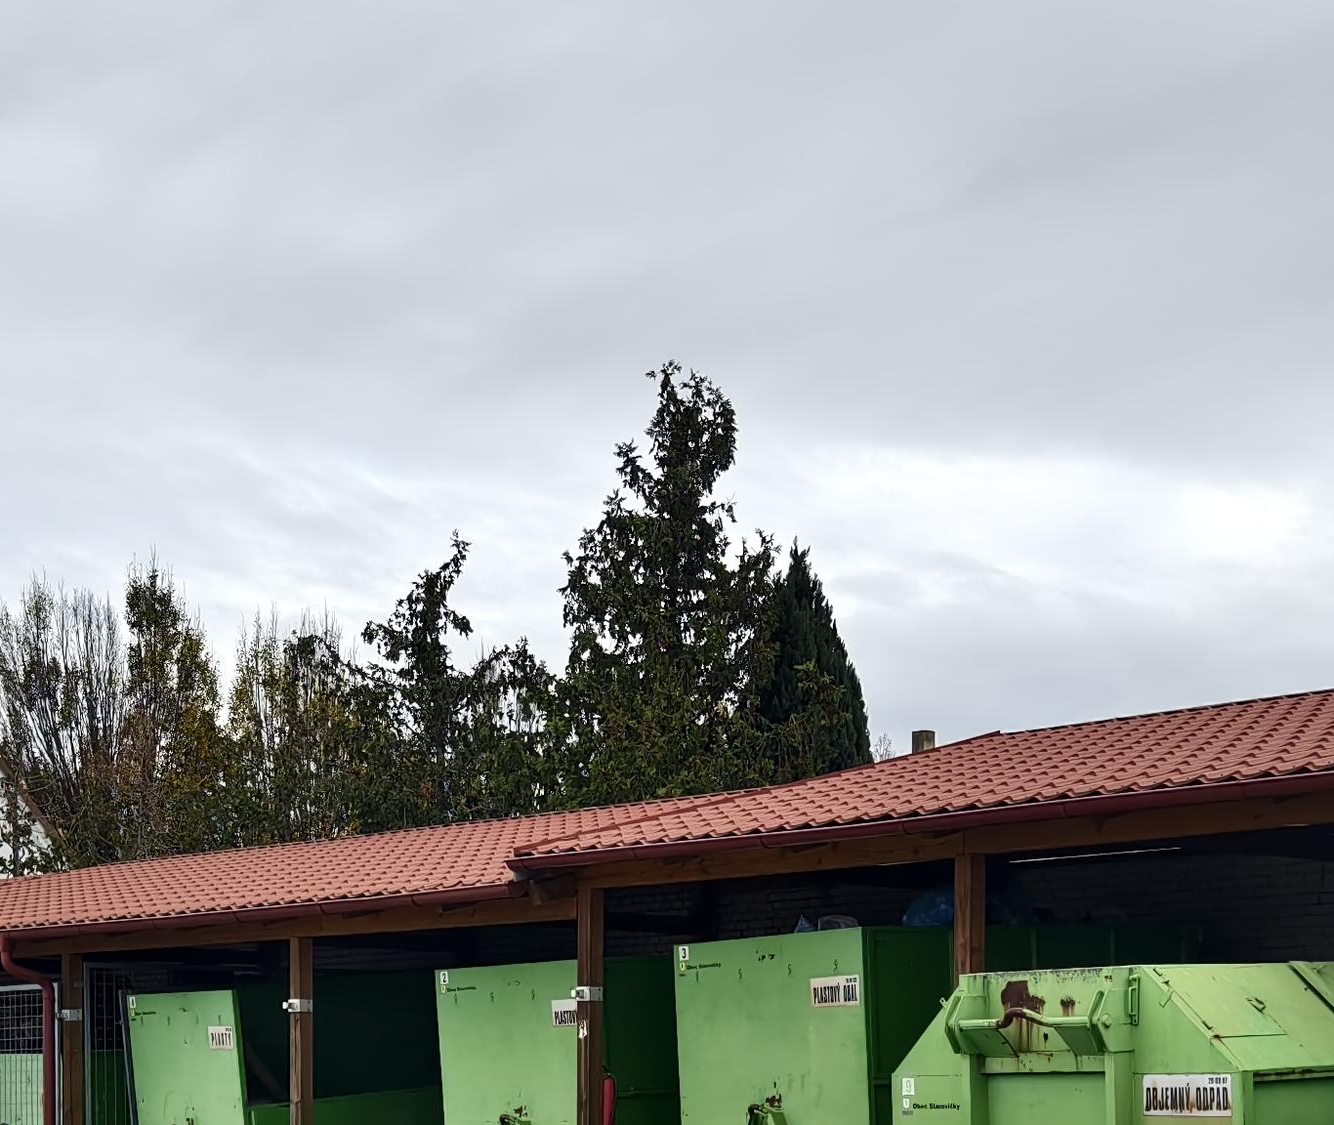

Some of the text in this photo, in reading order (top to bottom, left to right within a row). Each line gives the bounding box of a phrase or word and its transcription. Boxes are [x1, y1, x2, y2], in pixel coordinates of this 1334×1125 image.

[681, 947, 687, 959] 3
[441, 972, 447, 983] 2
[905, 1079, 912, 1093] 9
[1145, 1082, 1229, 1112] OBJEMNÝ ODPAD
